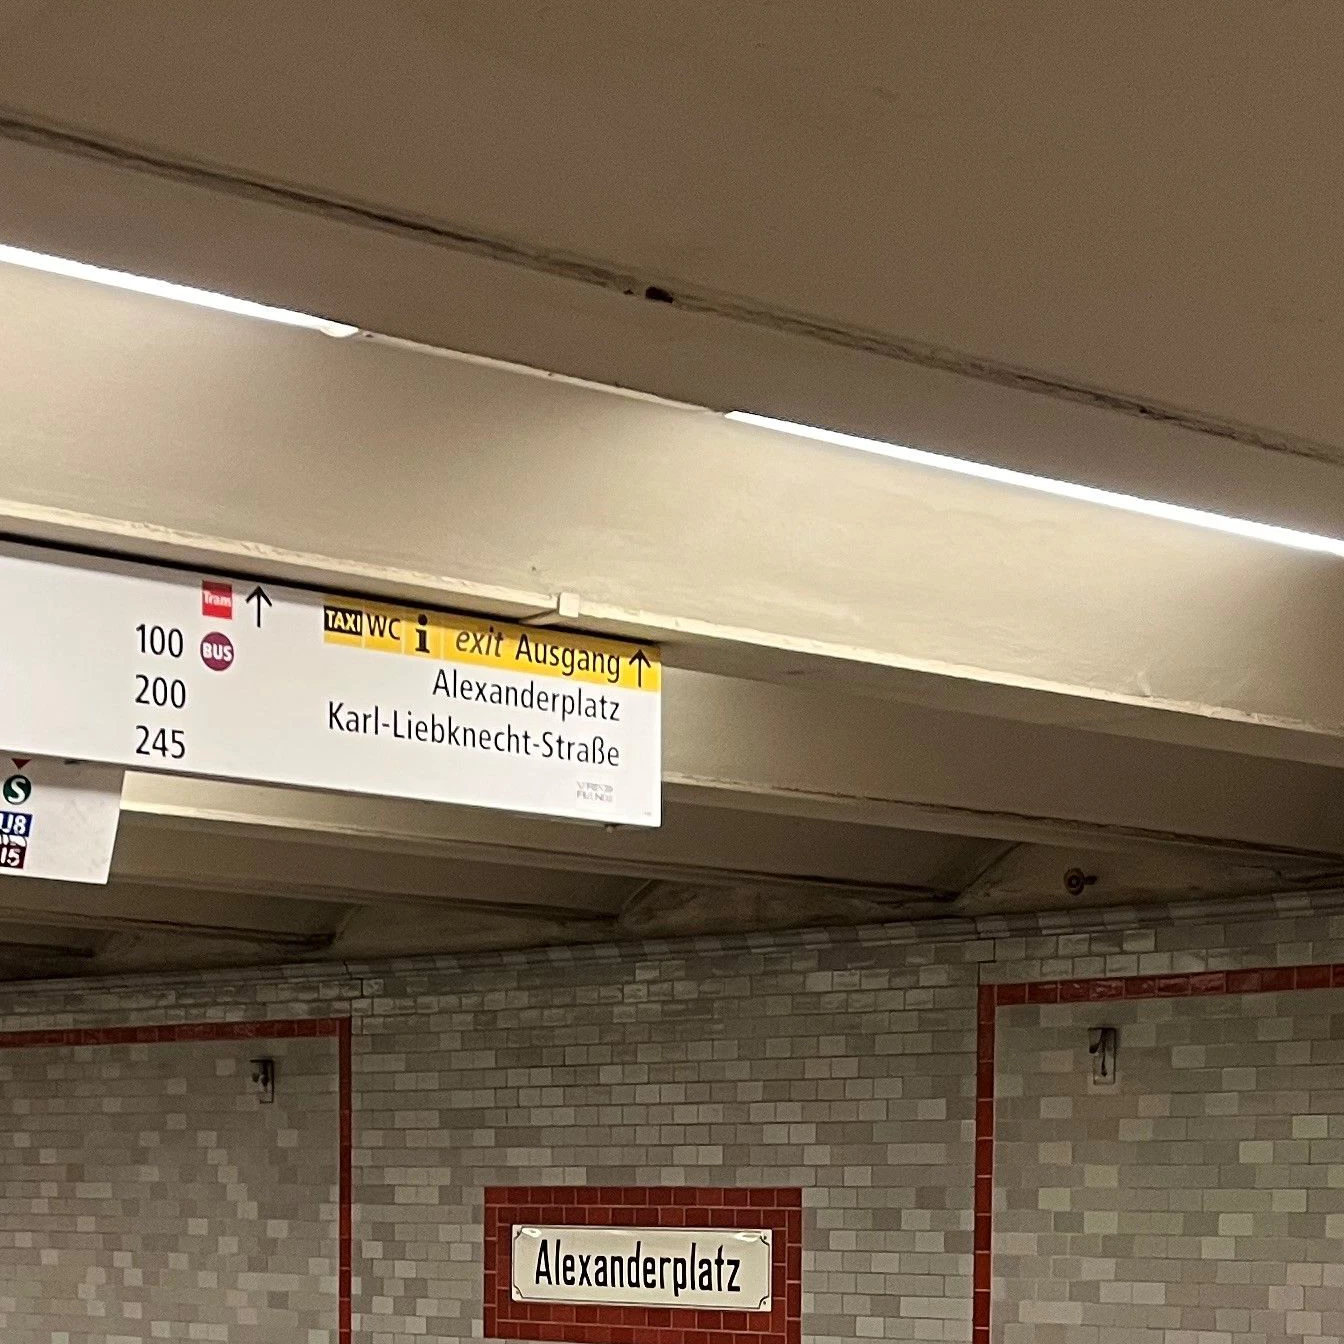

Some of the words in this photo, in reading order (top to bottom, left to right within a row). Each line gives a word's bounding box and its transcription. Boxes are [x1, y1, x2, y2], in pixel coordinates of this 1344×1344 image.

[203, 590, 231, 607] Tram
[136, 624, 183, 658] 100
[202, 642, 232, 662] BUS
[326, 609, 361, 635] TAXI
[367, 614, 401, 641] WC
[456, 626, 504, 657] exit
[516, 634, 620, 683] Ausgang
[135, 674, 186, 708] 200
[432, 668, 620, 722] Alexanderplatz
[136, 725, 185, 759] 245
[328, 701, 620, 767] Karl-Liebknecht-Straße
[6, 775, 29, 804] S
[535, 1239, 741, 1297] Alexanderplatz
